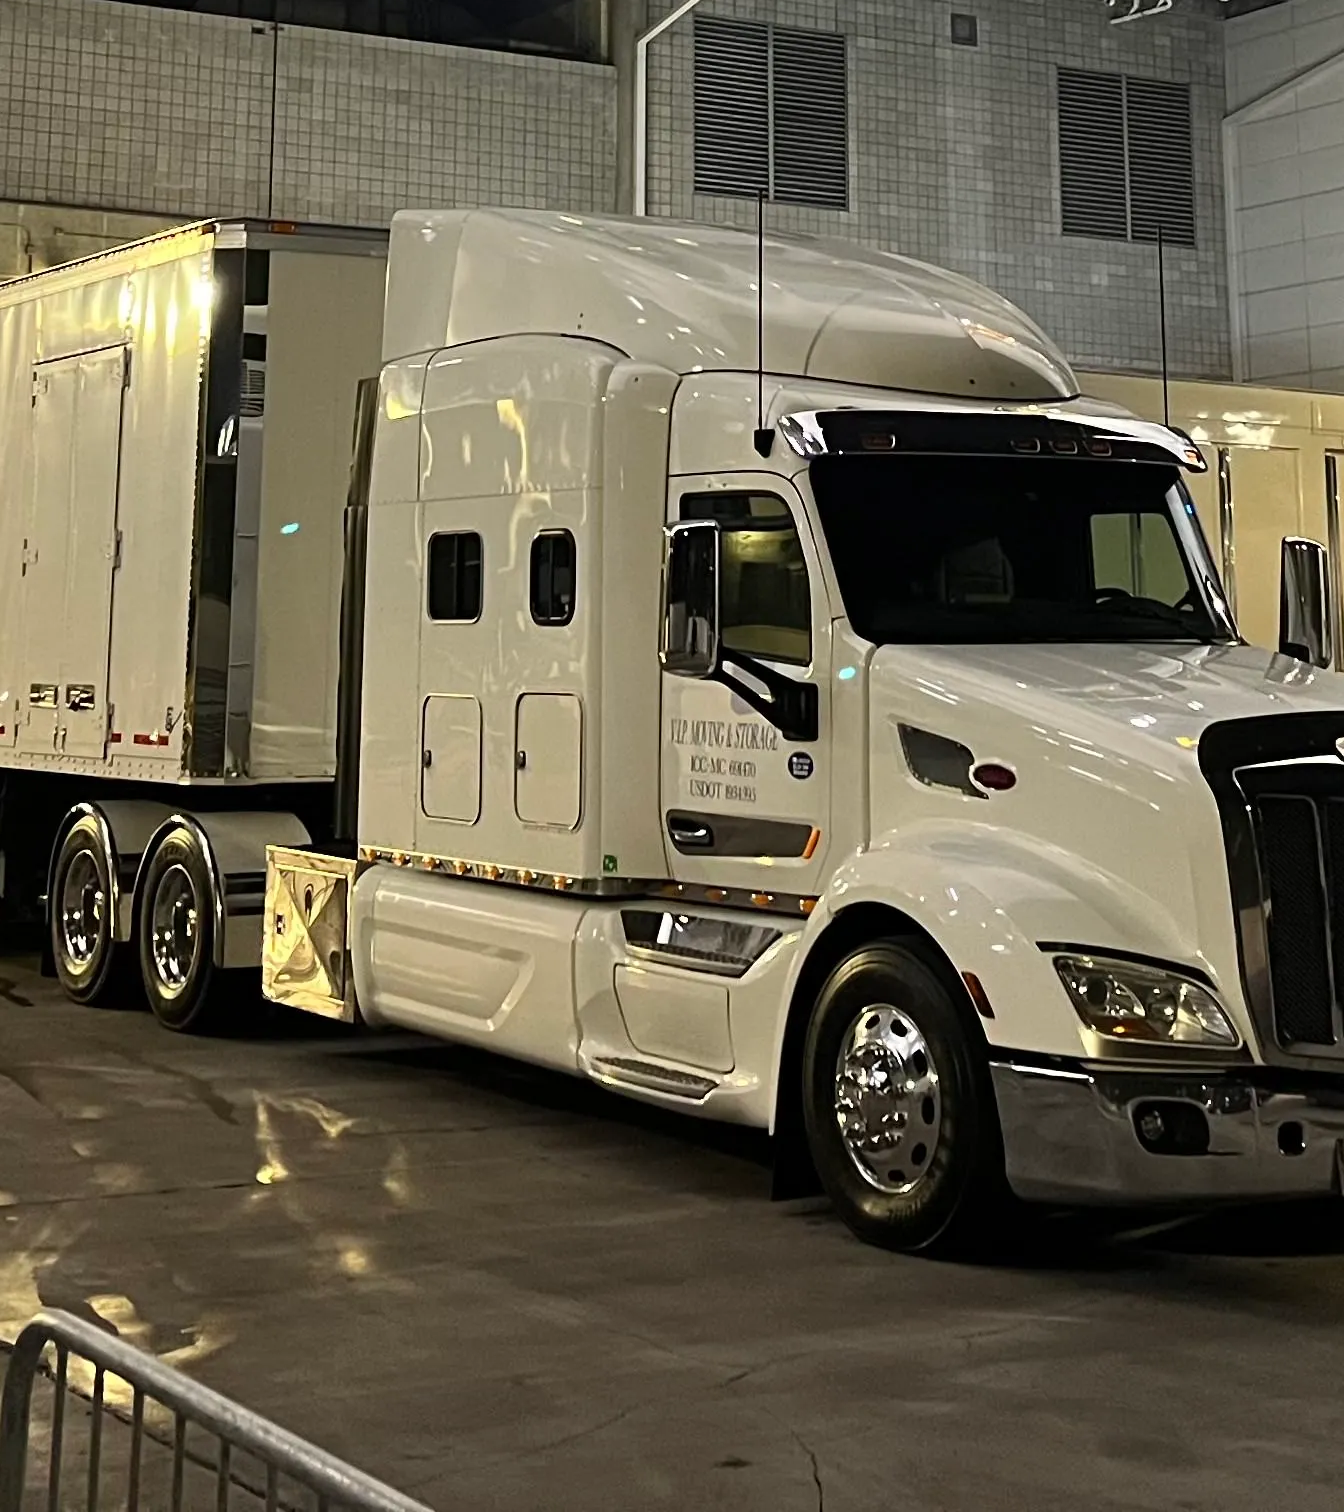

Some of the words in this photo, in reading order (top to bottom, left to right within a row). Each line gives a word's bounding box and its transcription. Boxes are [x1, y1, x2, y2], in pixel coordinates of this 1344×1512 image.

[691, 720, 724, 748] MOVING
[726, 723, 733, 748] &
[735, 722, 778, 751] STORAGE
[689, 779, 723, 800] USDOT
